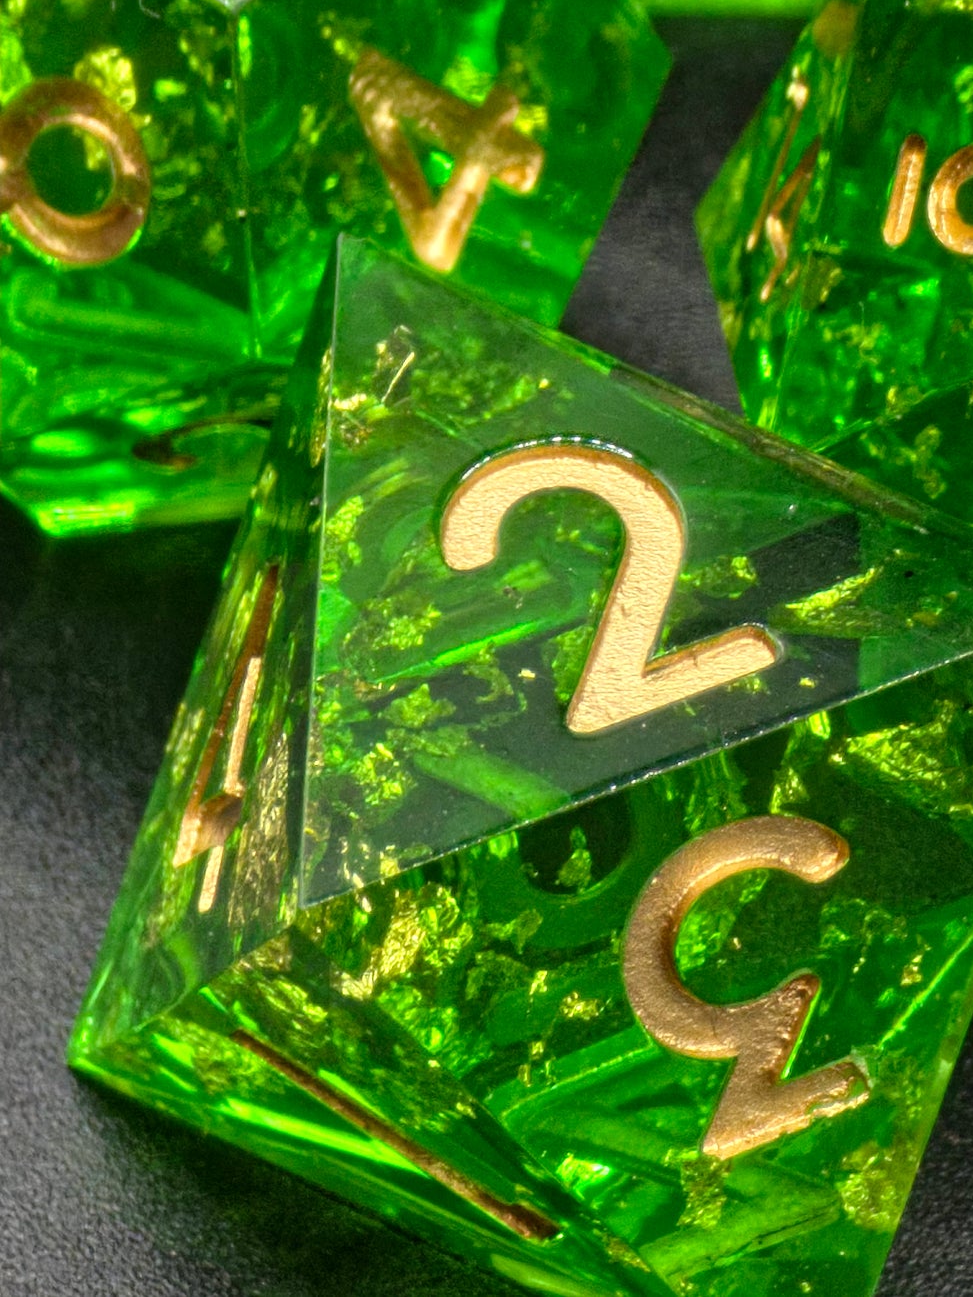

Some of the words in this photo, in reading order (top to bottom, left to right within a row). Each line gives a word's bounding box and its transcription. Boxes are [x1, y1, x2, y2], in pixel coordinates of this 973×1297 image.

[347, 46, 545, 271] 4
[440, 438, 782, 735] 2
[623, 815, 872, 1160] 3
